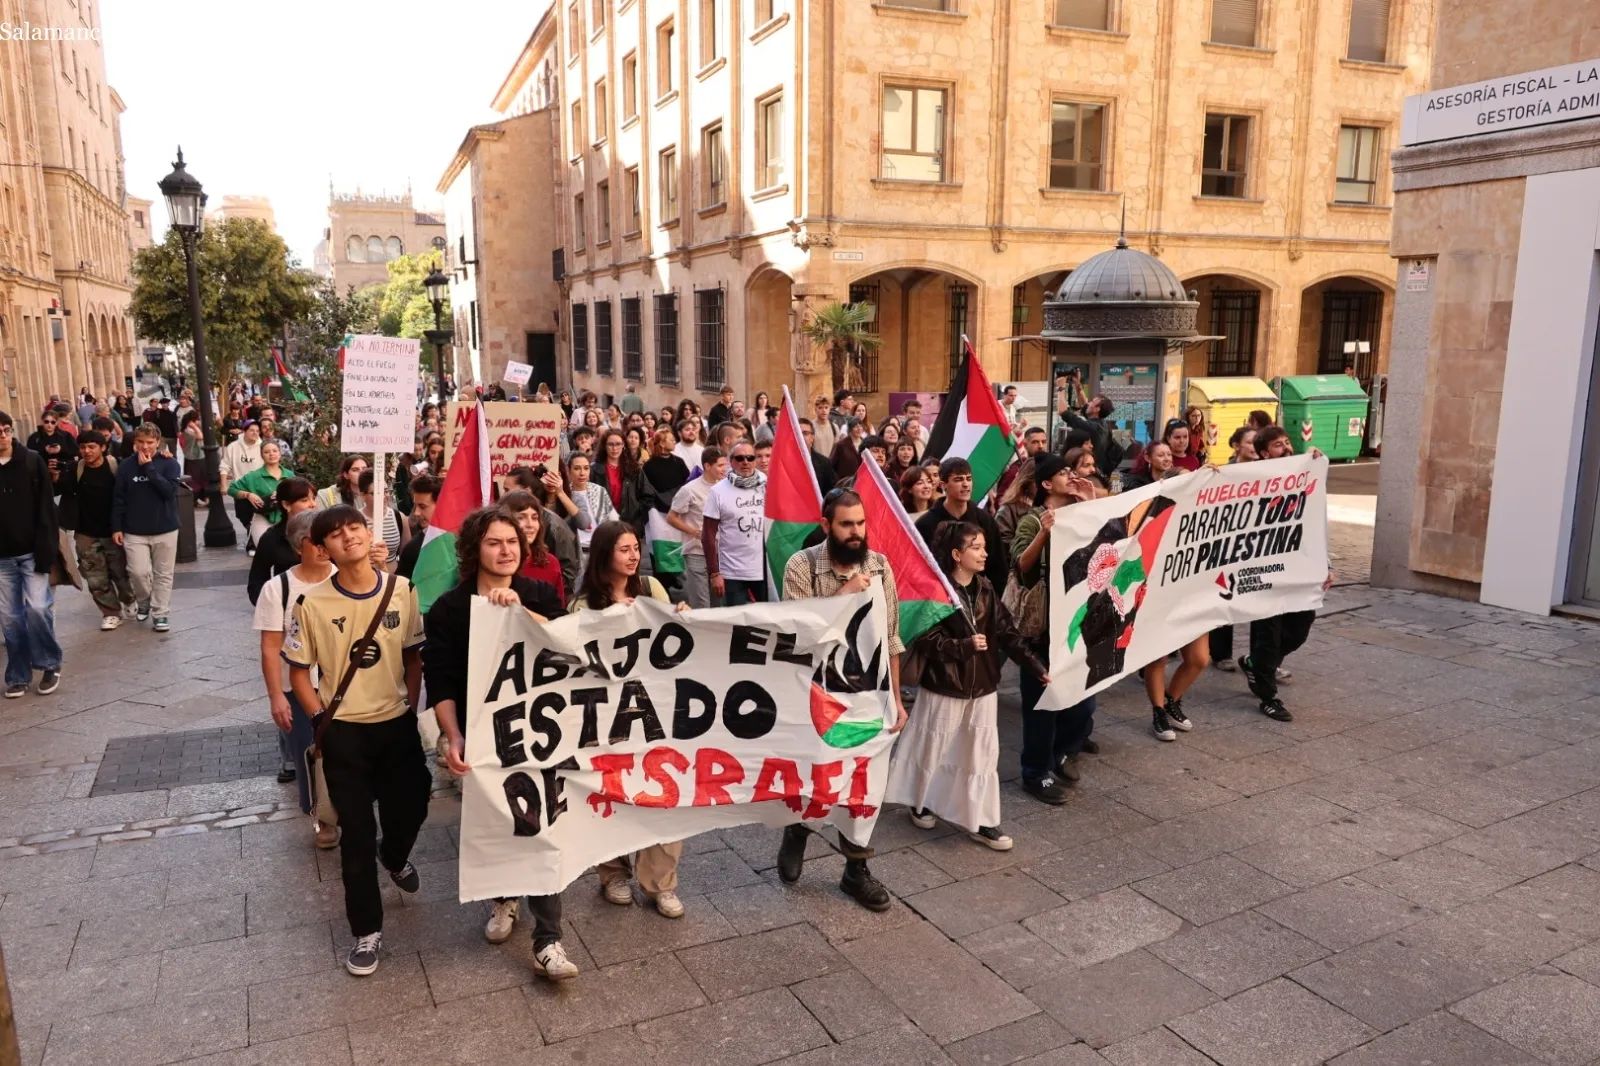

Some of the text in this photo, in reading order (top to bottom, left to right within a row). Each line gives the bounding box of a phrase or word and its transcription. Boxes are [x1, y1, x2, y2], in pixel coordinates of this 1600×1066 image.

[1426, 85, 1498, 112] ASESORÍA
[1502, 76, 1558, 98] FISCAL
[1576, 67, 1599, 84] LA
[1476, 92, 1600, 126] GESTORÍA ADMI
[347, 358, 396, 370] ALTO EL FUEGO
[369, 340, 380, 352] NO
[382, 340, 415, 355] TERMINA
[497, 433, 557, 450] GENOCIDIO
[240, 454, 255, 464] blur
[1196, 470, 1311, 506] HUELGA 15 OCT
[1176, 491, 1307, 547] PARARLO TODO
[1160, 523, 1303, 586] POR PALESTINA
[1238, 563, 1285, 578] COORDINADORA
[1237, 575, 1263, 587] JUVENIL
[1237, 583, 1272, 595] SOCIALISTA
[485, 622, 815, 702] ABAJO EL
[492, 678, 777, 768] ESTADO
[503, 746, 878, 837] DE ISRAEL
